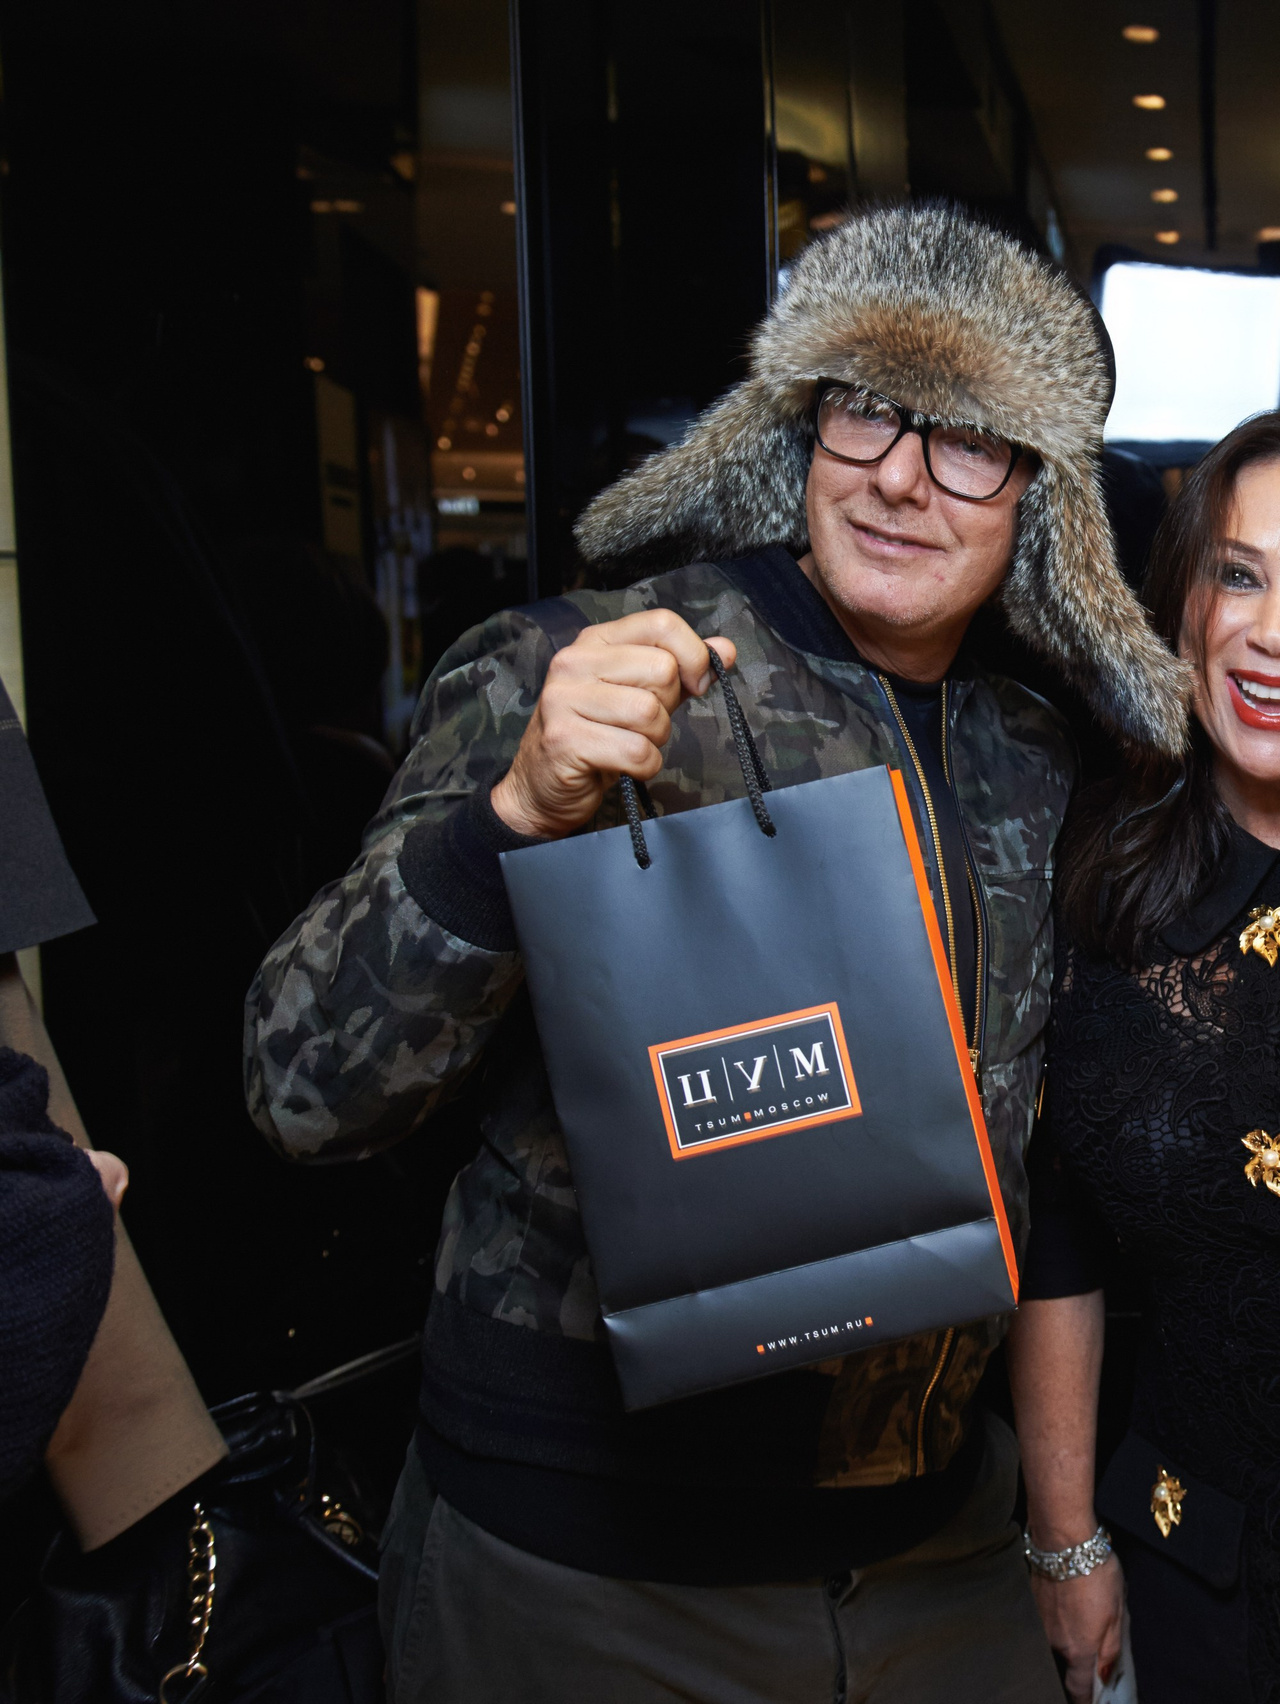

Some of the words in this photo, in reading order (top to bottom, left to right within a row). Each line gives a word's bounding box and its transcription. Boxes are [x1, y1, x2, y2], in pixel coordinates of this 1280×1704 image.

[695, 1114, 742, 1132] TSUM
[754, 1092, 829, 1118] MOSCOW
[767, 1319, 862, 1351] WWW.TSUM.RU
